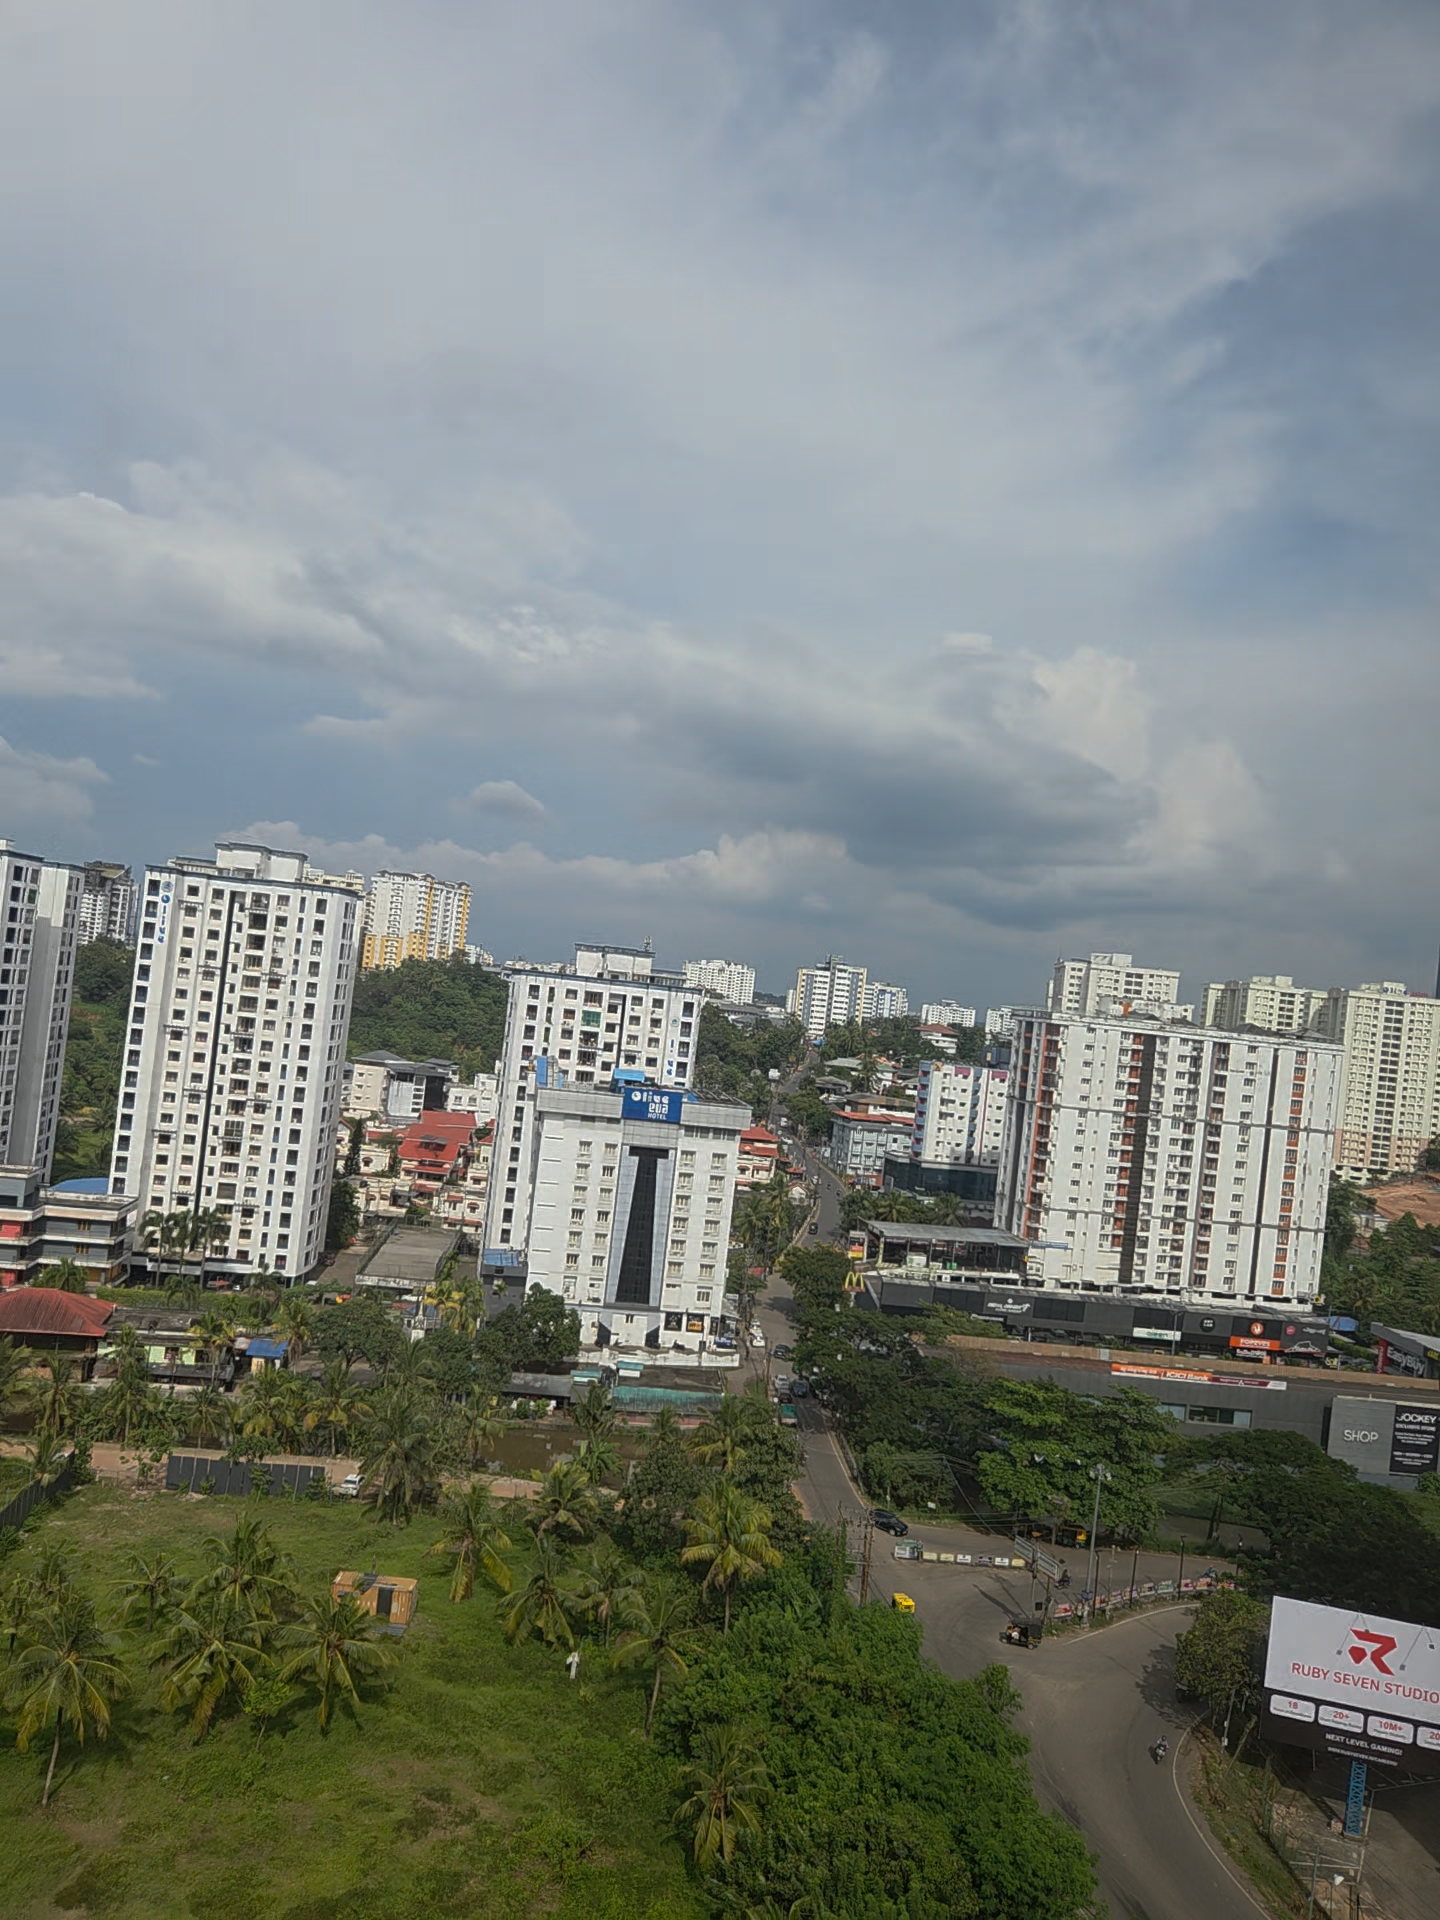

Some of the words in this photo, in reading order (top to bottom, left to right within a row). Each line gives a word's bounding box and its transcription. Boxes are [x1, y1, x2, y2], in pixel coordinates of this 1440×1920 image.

[631, 1091, 670, 1104] Olive
[1166, 1371, 1187, 1380] ICICI
[1187, 1373, 1209, 1382] Bank
[1396, 1413, 1438, 1424] JOCKEY
[1343, 1429, 1379, 1443] SHOP
[1291, 1662, 1330, 1681] RUBY
[1333, 1670, 1380, 1692] SEVEN
[1384, 1682, 1440, 1704] STUDIO
[1288, 1700, 1299, 1710] 18
[1333, 1710, 1350, 1720] 20+
[1379, 1720, 1404, 1732] 10M+
[1325, 1733, 1345, 1743] NEXT
[1346, 1738, 1370, 1749] LEVEL
[1370, 1743, 1403, 1756] GAMING!
